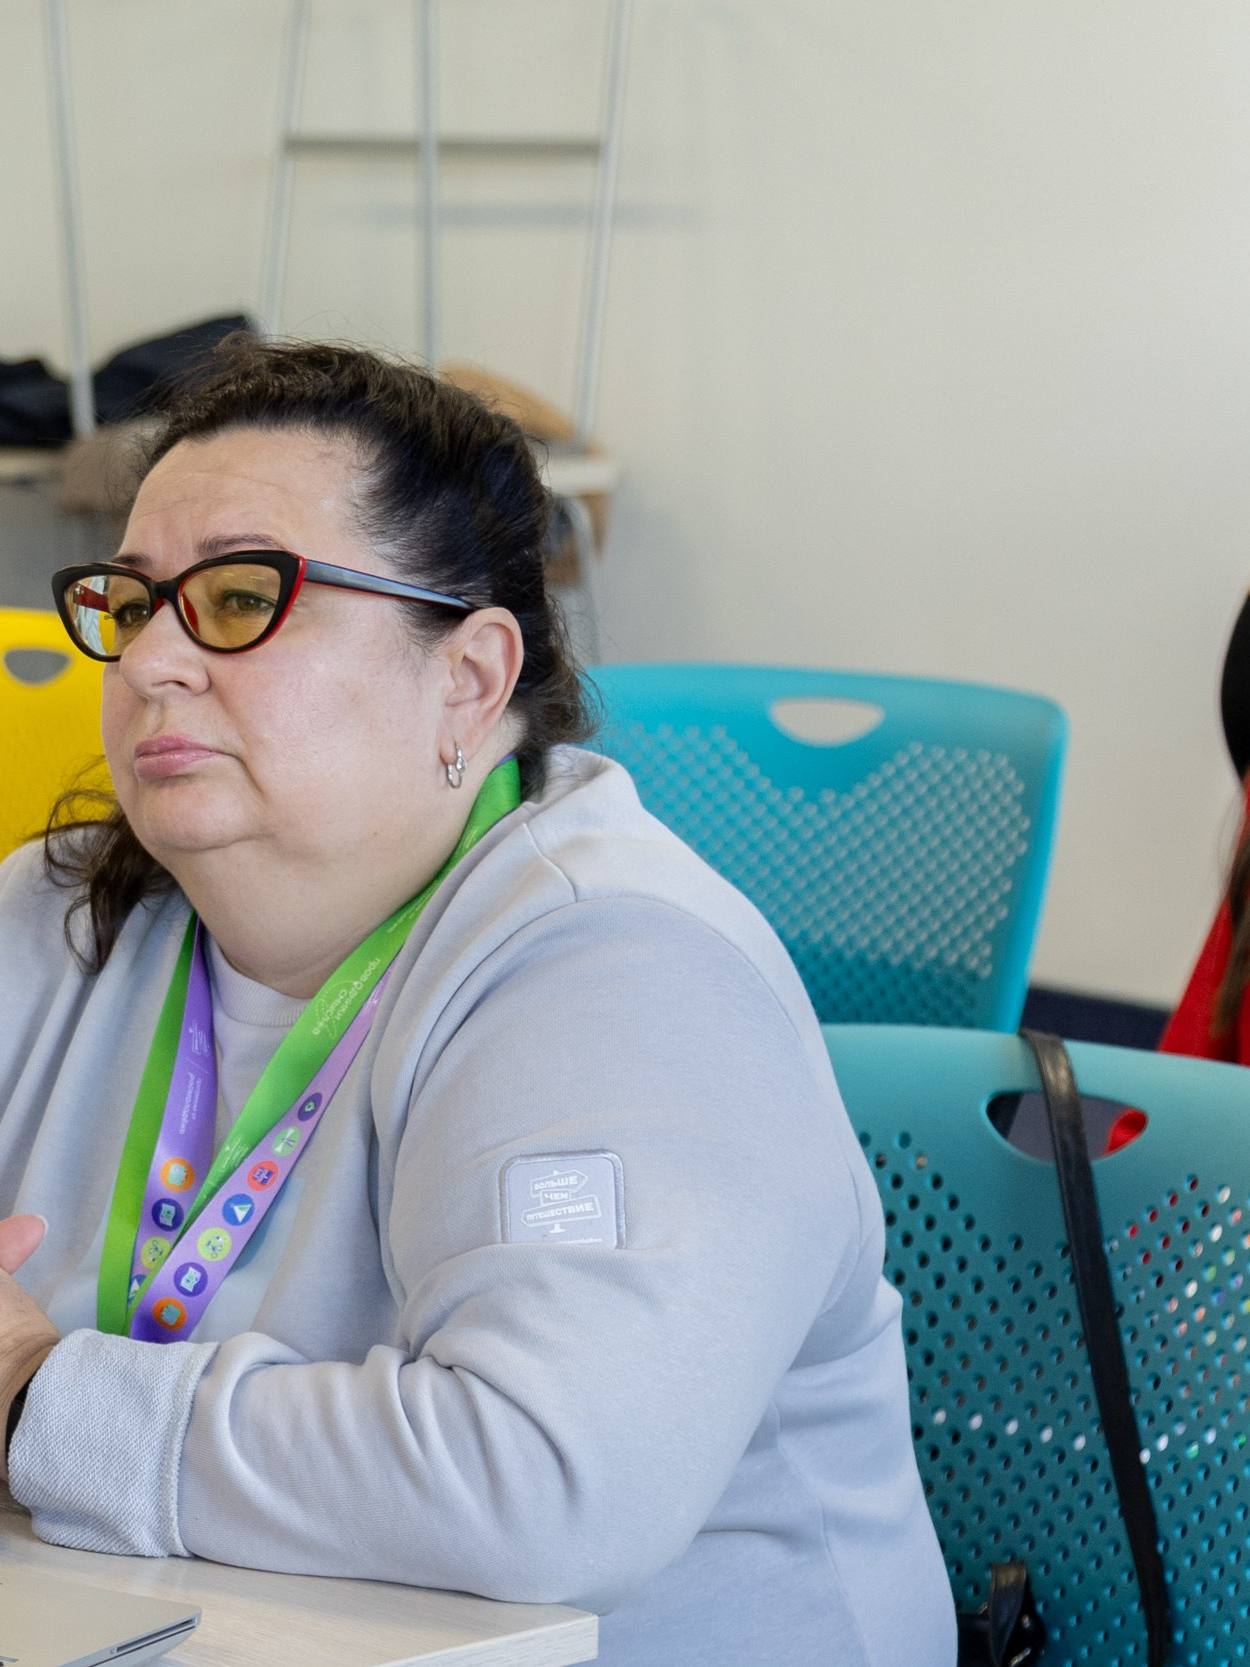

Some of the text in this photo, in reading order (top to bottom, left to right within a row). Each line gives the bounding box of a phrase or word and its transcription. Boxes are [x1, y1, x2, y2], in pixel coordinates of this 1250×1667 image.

[534, 1175, 579, 1191] БОЛЬШЕ
[544, 1192, 569, 1201] ЧЕМ
[526, 1202, 595, 1222] ПУТЕШЕСТВИЕ
